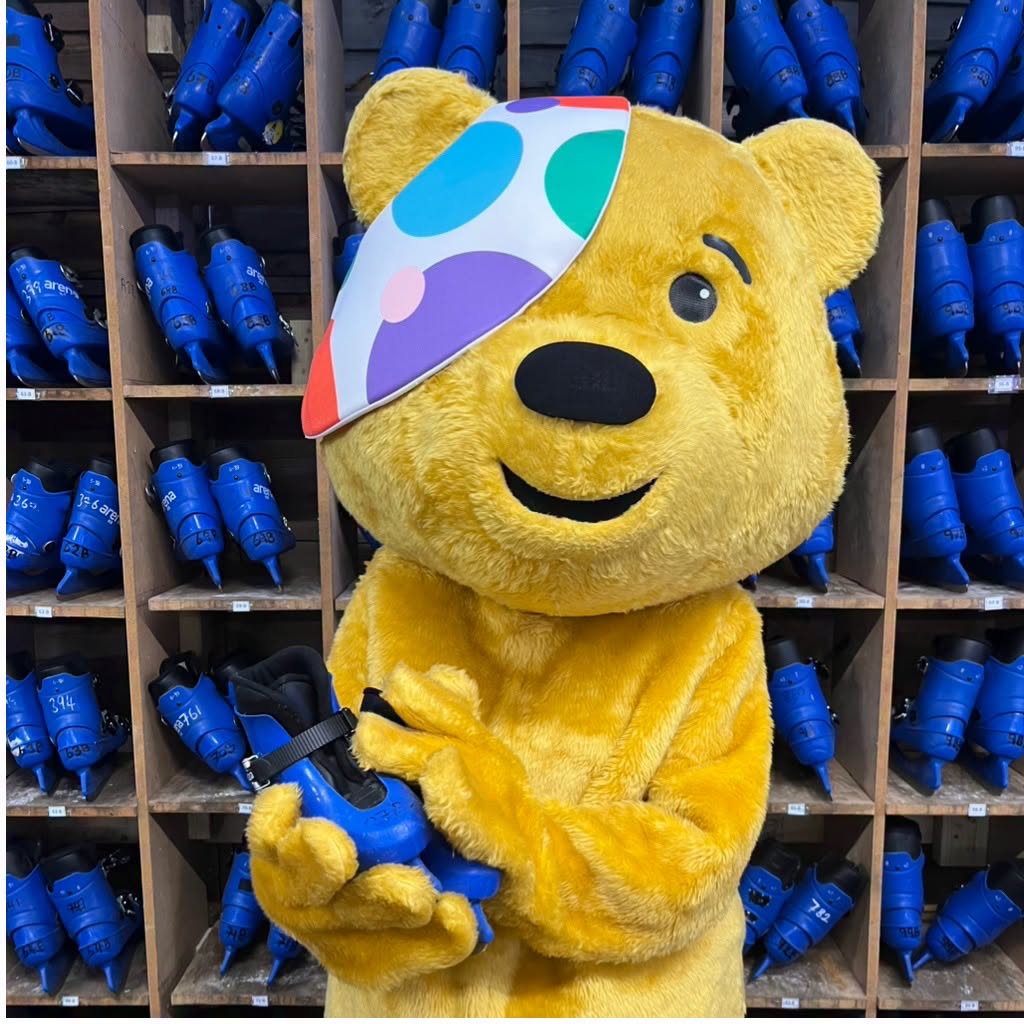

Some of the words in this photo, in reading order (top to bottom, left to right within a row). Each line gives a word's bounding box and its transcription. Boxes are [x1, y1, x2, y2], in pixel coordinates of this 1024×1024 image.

[48, 694, 77, 713] 394
[178, 704, 203, 727] 761
[807, 897, 832, 924] 782
